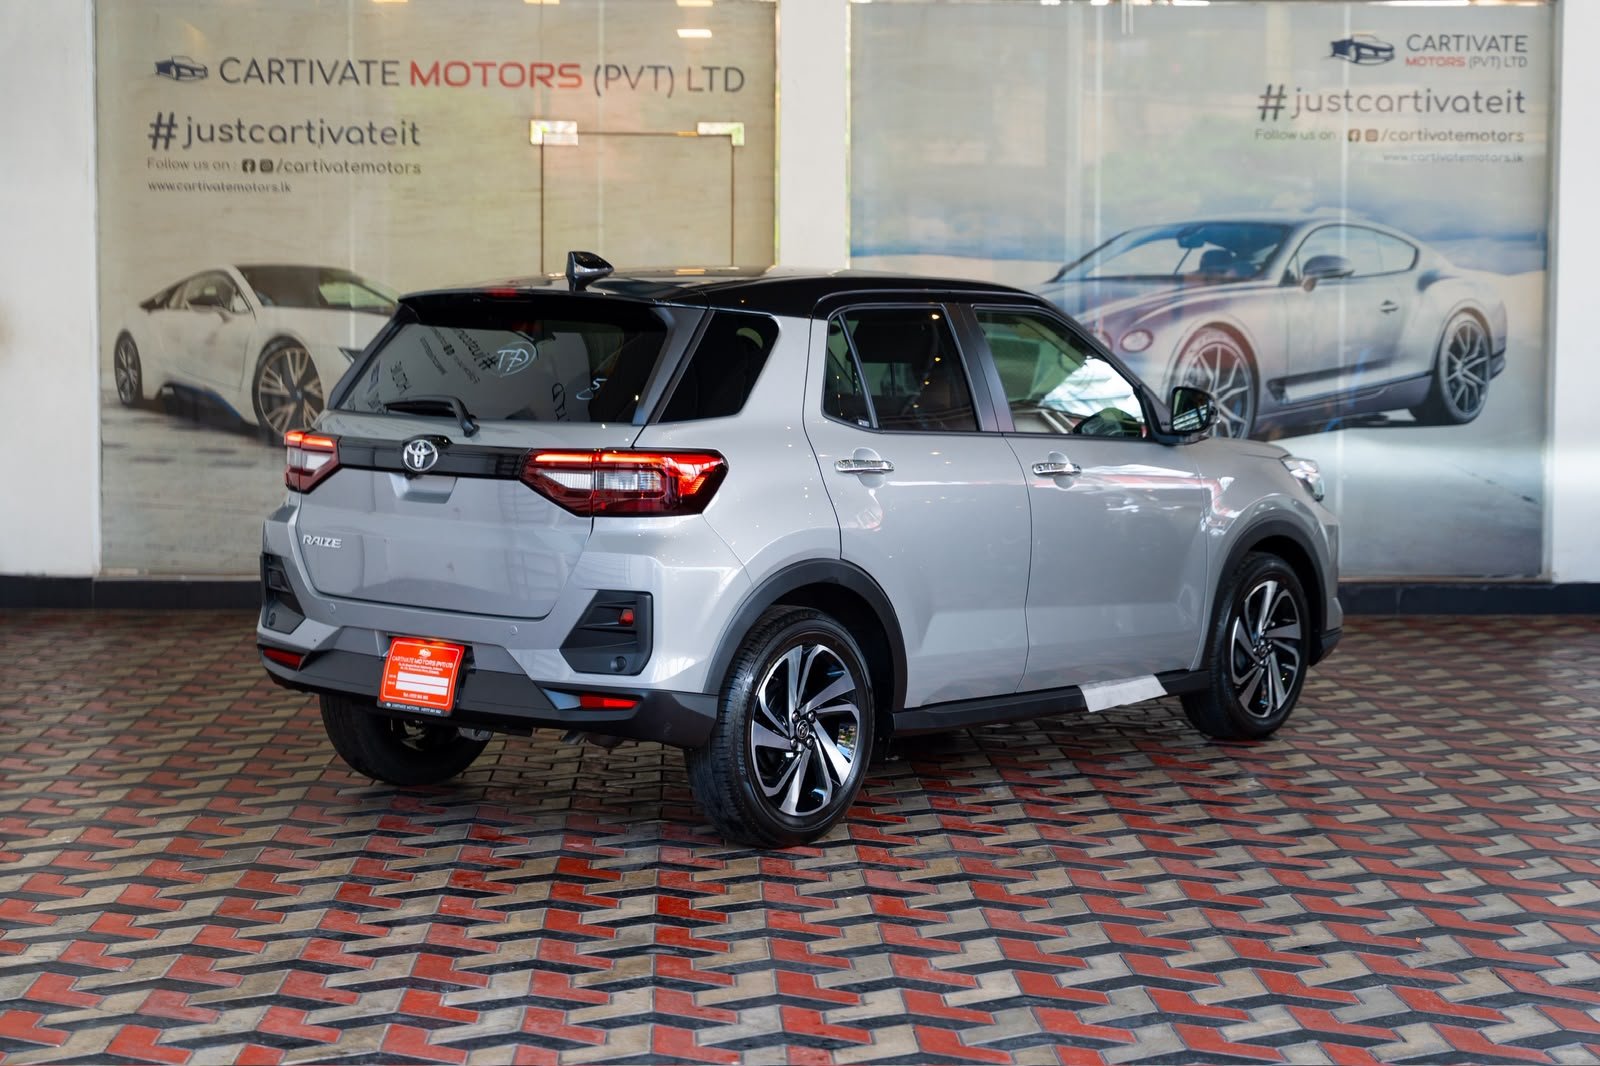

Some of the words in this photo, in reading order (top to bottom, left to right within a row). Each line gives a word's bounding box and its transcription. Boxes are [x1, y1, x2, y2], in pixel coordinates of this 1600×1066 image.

[1406, 34, 1529, 53] CARTIVATE
[1405, 56, 1466, 67] MOTORS
[1469, 56, 1500, 69] (PVT)
[1503, 56, 1529, 68] LTD
[219, 56, 400, 87] CARTIVATE
[410, 61, 583, 88] MOTORS
[594, 64, 674, 98] (PVT)
[687, 66, 745, 93] LTD
[1257, 84, 1526, 122] #justcartivateit
[148, 111, 421, 150] #justcartivateit
[1255, 128, 1297, 141] Follow
[1300, 131, 1316, 141] us
[146, 157, 189, 169] Follow
[193, 160, 209, 169] us
[302, 533, 342, 549] RAIZE
